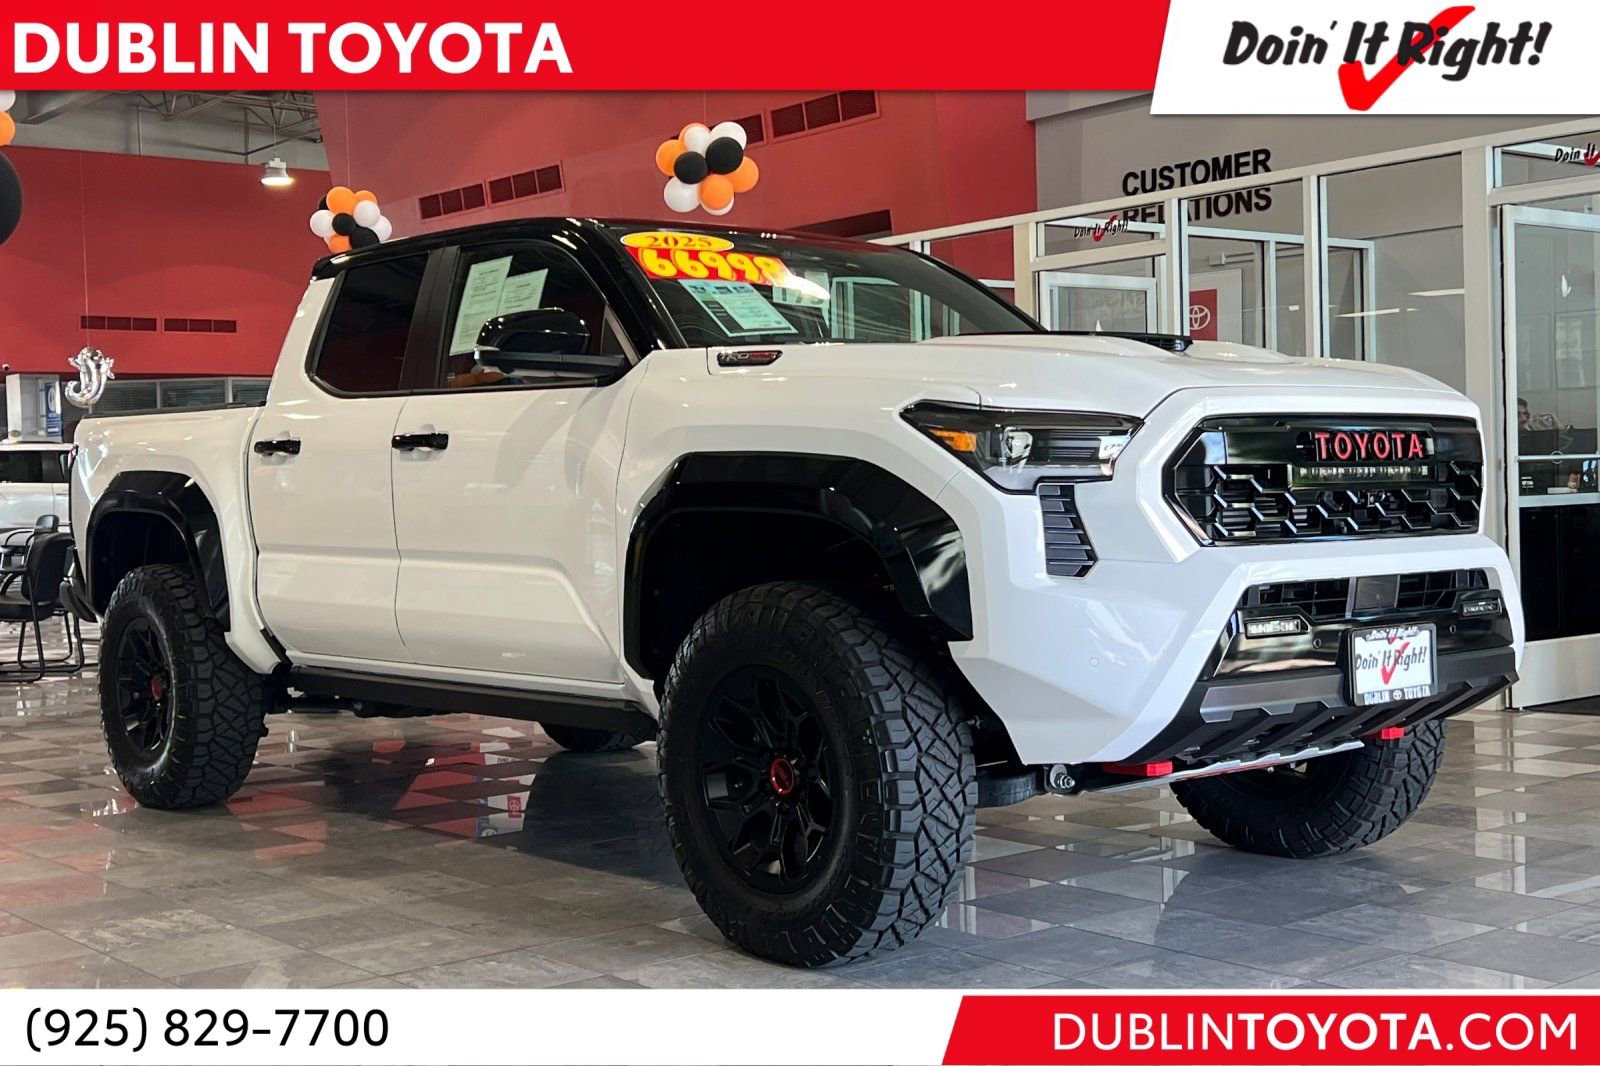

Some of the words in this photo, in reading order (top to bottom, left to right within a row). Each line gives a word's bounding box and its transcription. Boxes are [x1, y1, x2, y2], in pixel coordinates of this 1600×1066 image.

[1122, 148, 1272, 197] CUSTOMER
[1123, 187, 1273, 224] RELTIONS
[650, 235, 713, 248] 2025
[1314, 432, 1424, 460] TOYOTA
[1355, 650, 1381, 671] Doin'
[1382, 649, 1392, 668] It
[1394, 646, 1428, 671] Right!
[1364, 690, 1390, 706] DUBLIN
[1404, 685, 1431, 700] TOYOTA
